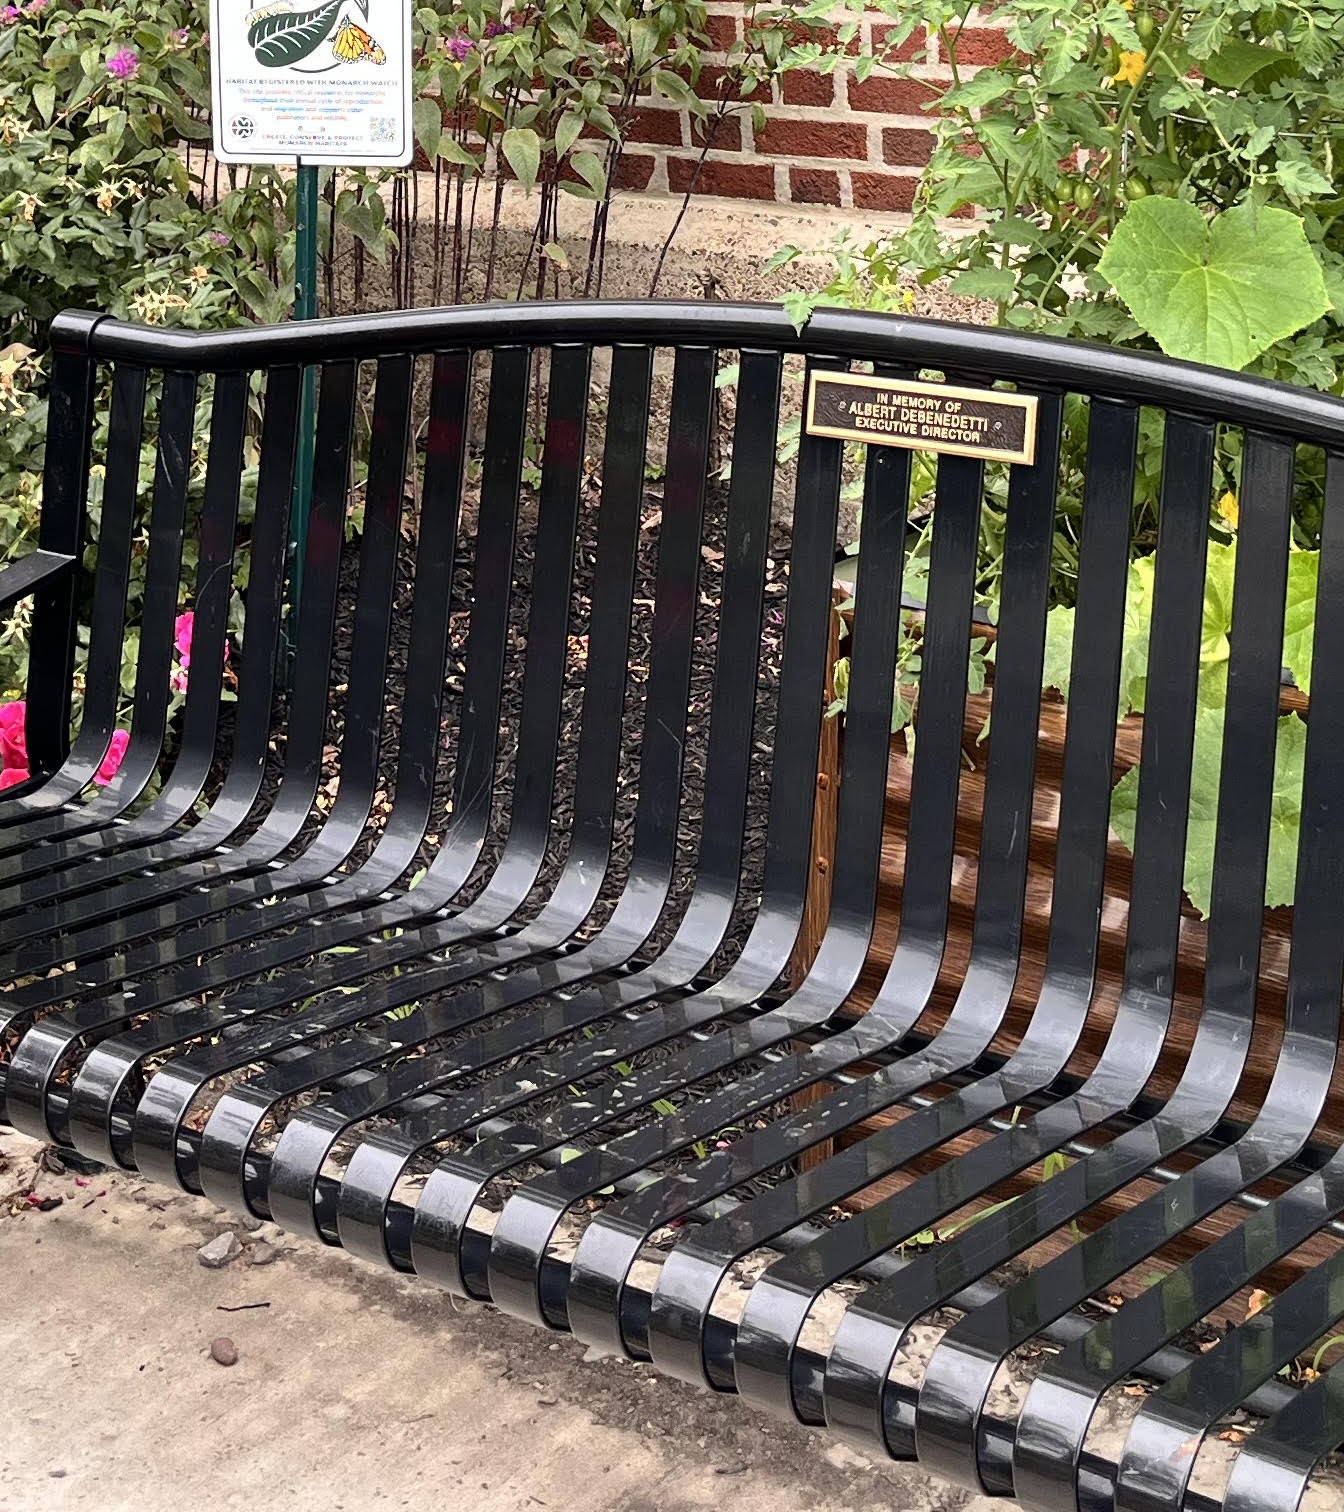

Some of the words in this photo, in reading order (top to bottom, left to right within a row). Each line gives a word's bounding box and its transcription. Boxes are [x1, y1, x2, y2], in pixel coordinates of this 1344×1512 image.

[848, 401, 897, 419] ALBERT
[900, 408, 988, 431] DEBENEDETTI
[877, 393, 888, 404] IN
[892, 395, 942, 410] MEMORY
[945, 401, 962, 413] OF
[855, 417, 918, 435] EXECUTIVE
[921, 426, 981, 443] DIRECTOR
